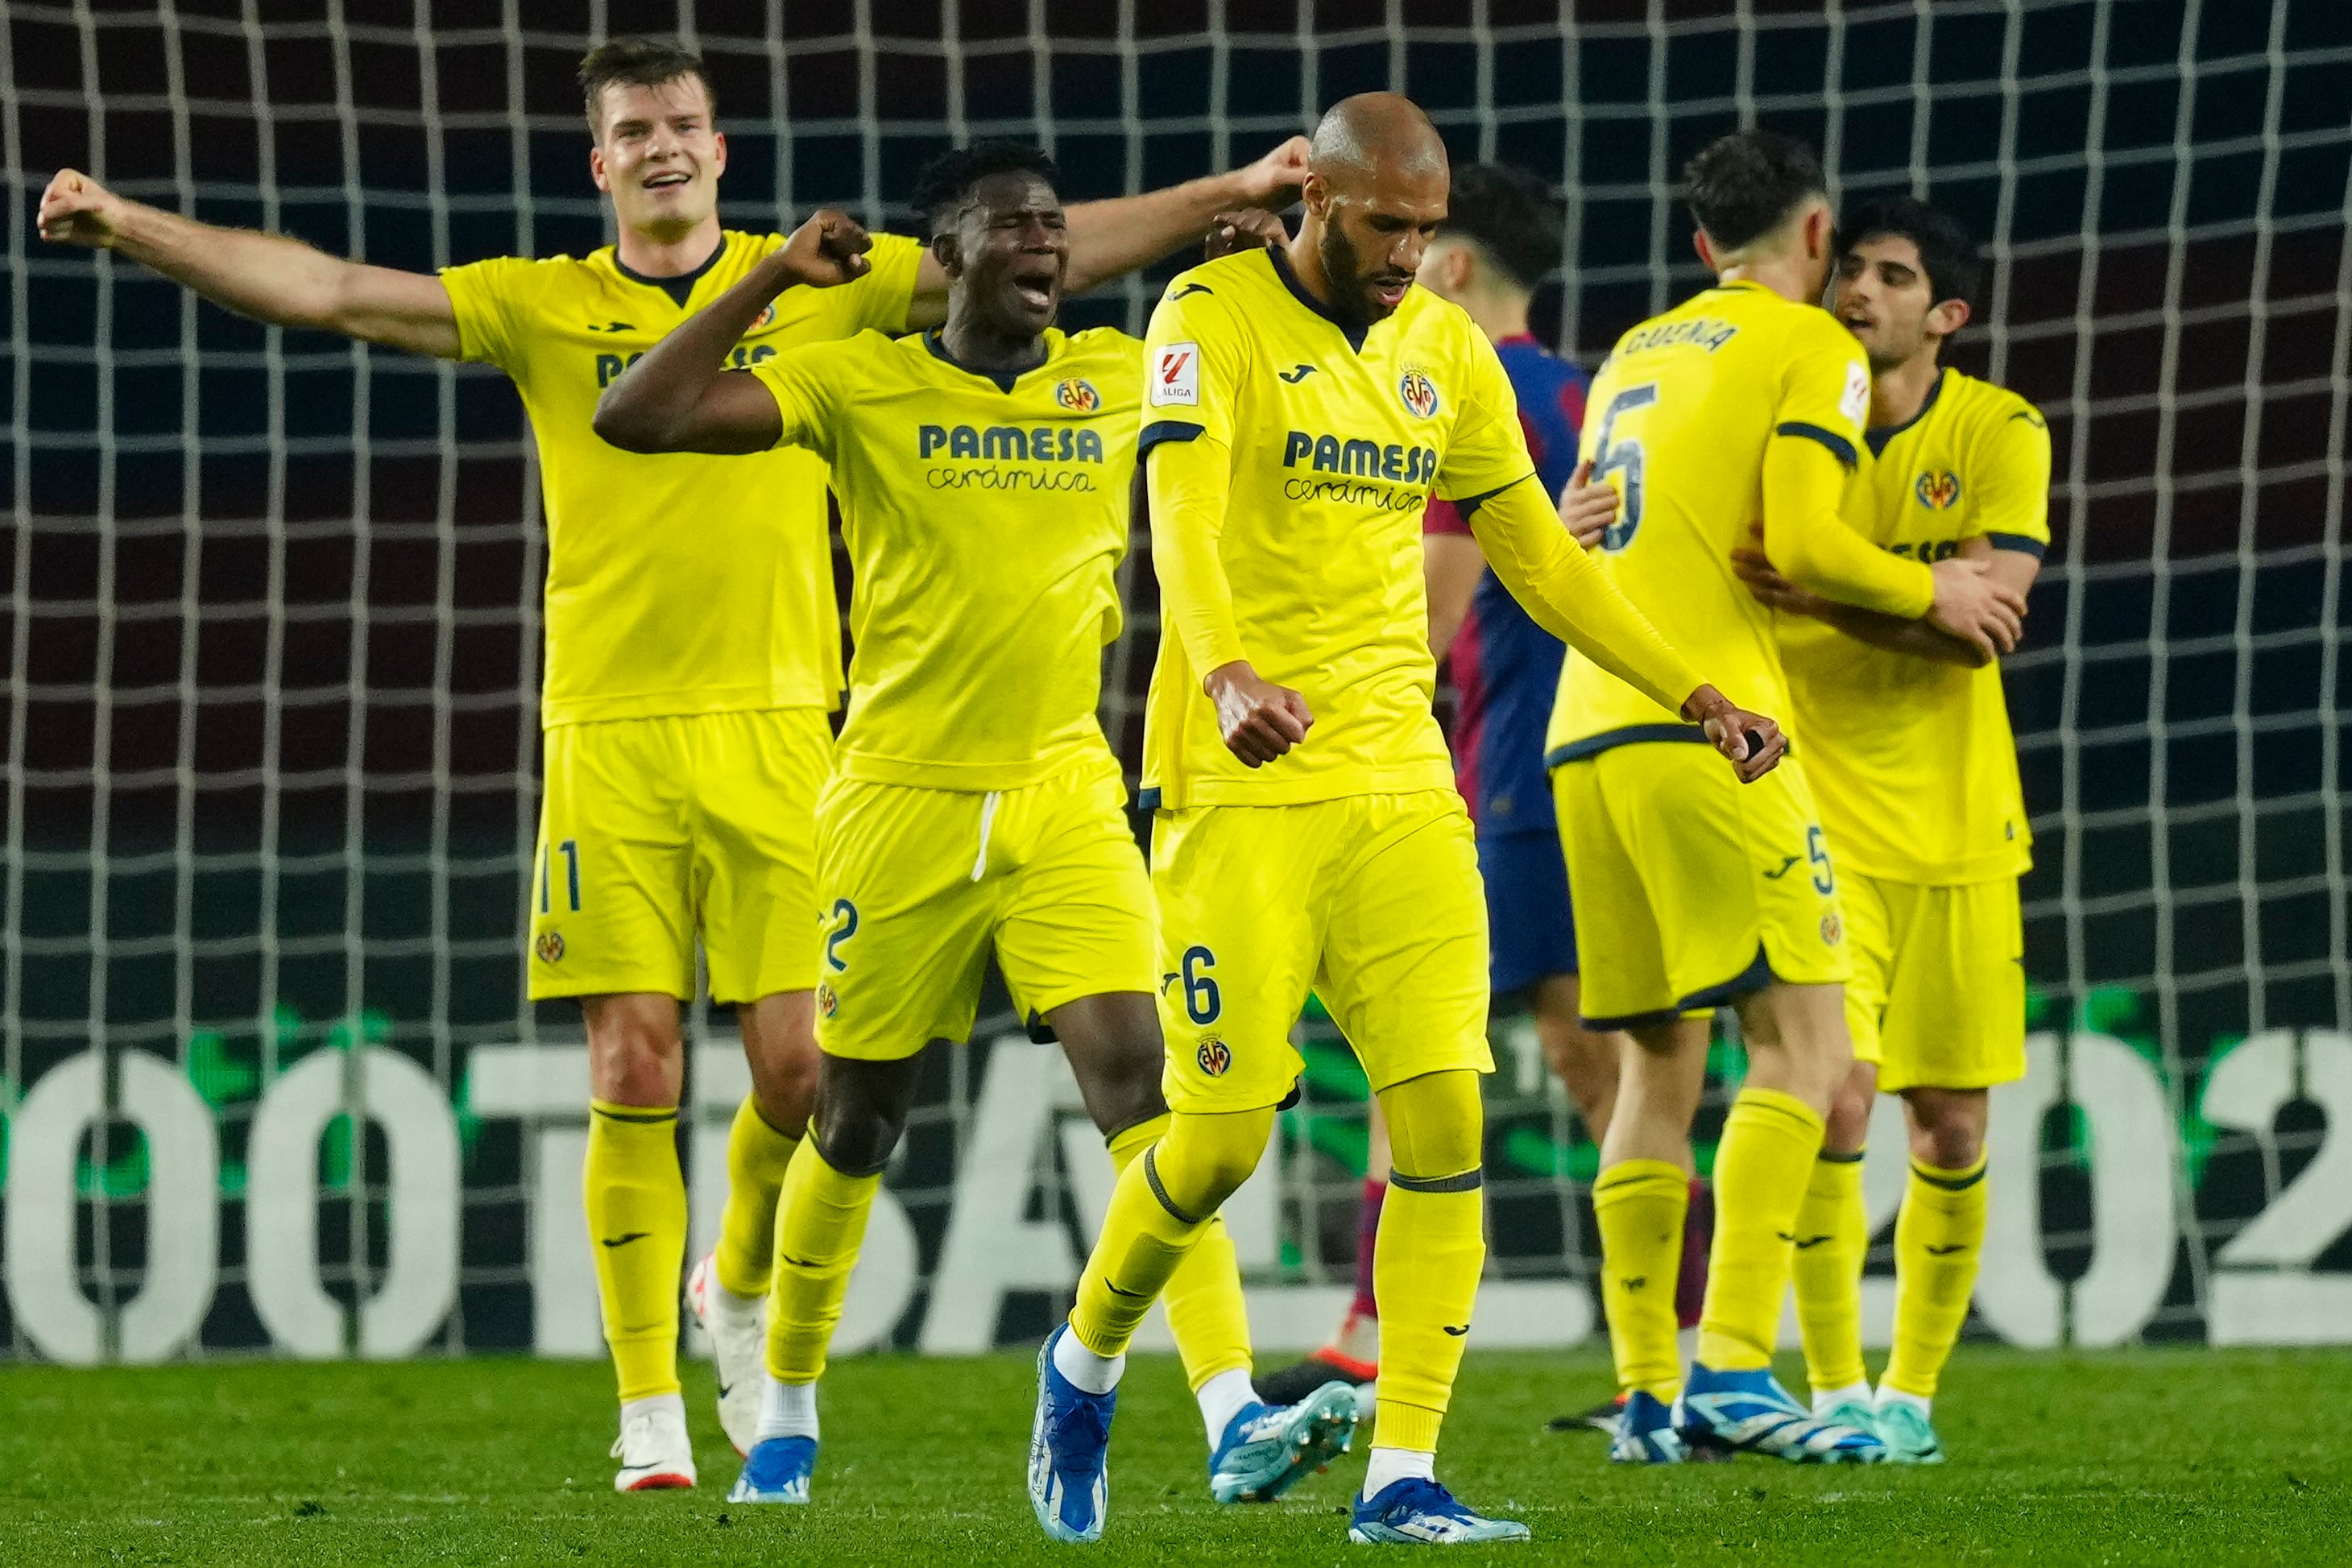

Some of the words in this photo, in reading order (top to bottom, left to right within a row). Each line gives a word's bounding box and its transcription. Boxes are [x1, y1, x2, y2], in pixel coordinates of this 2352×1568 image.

[919, 424, 1104, 464] PAMESA
[926, 465, 1097, 493] cerámica
[1282, 430, 1437, 486] PAMESA
[1590, 384, 1655, 552] 5
[540, 840, 580, 913] 11
[1807, 825, 1833, 896] 5
[827, 898, 859, 971] 2
[1182, 945, 1221, 1025] 6
